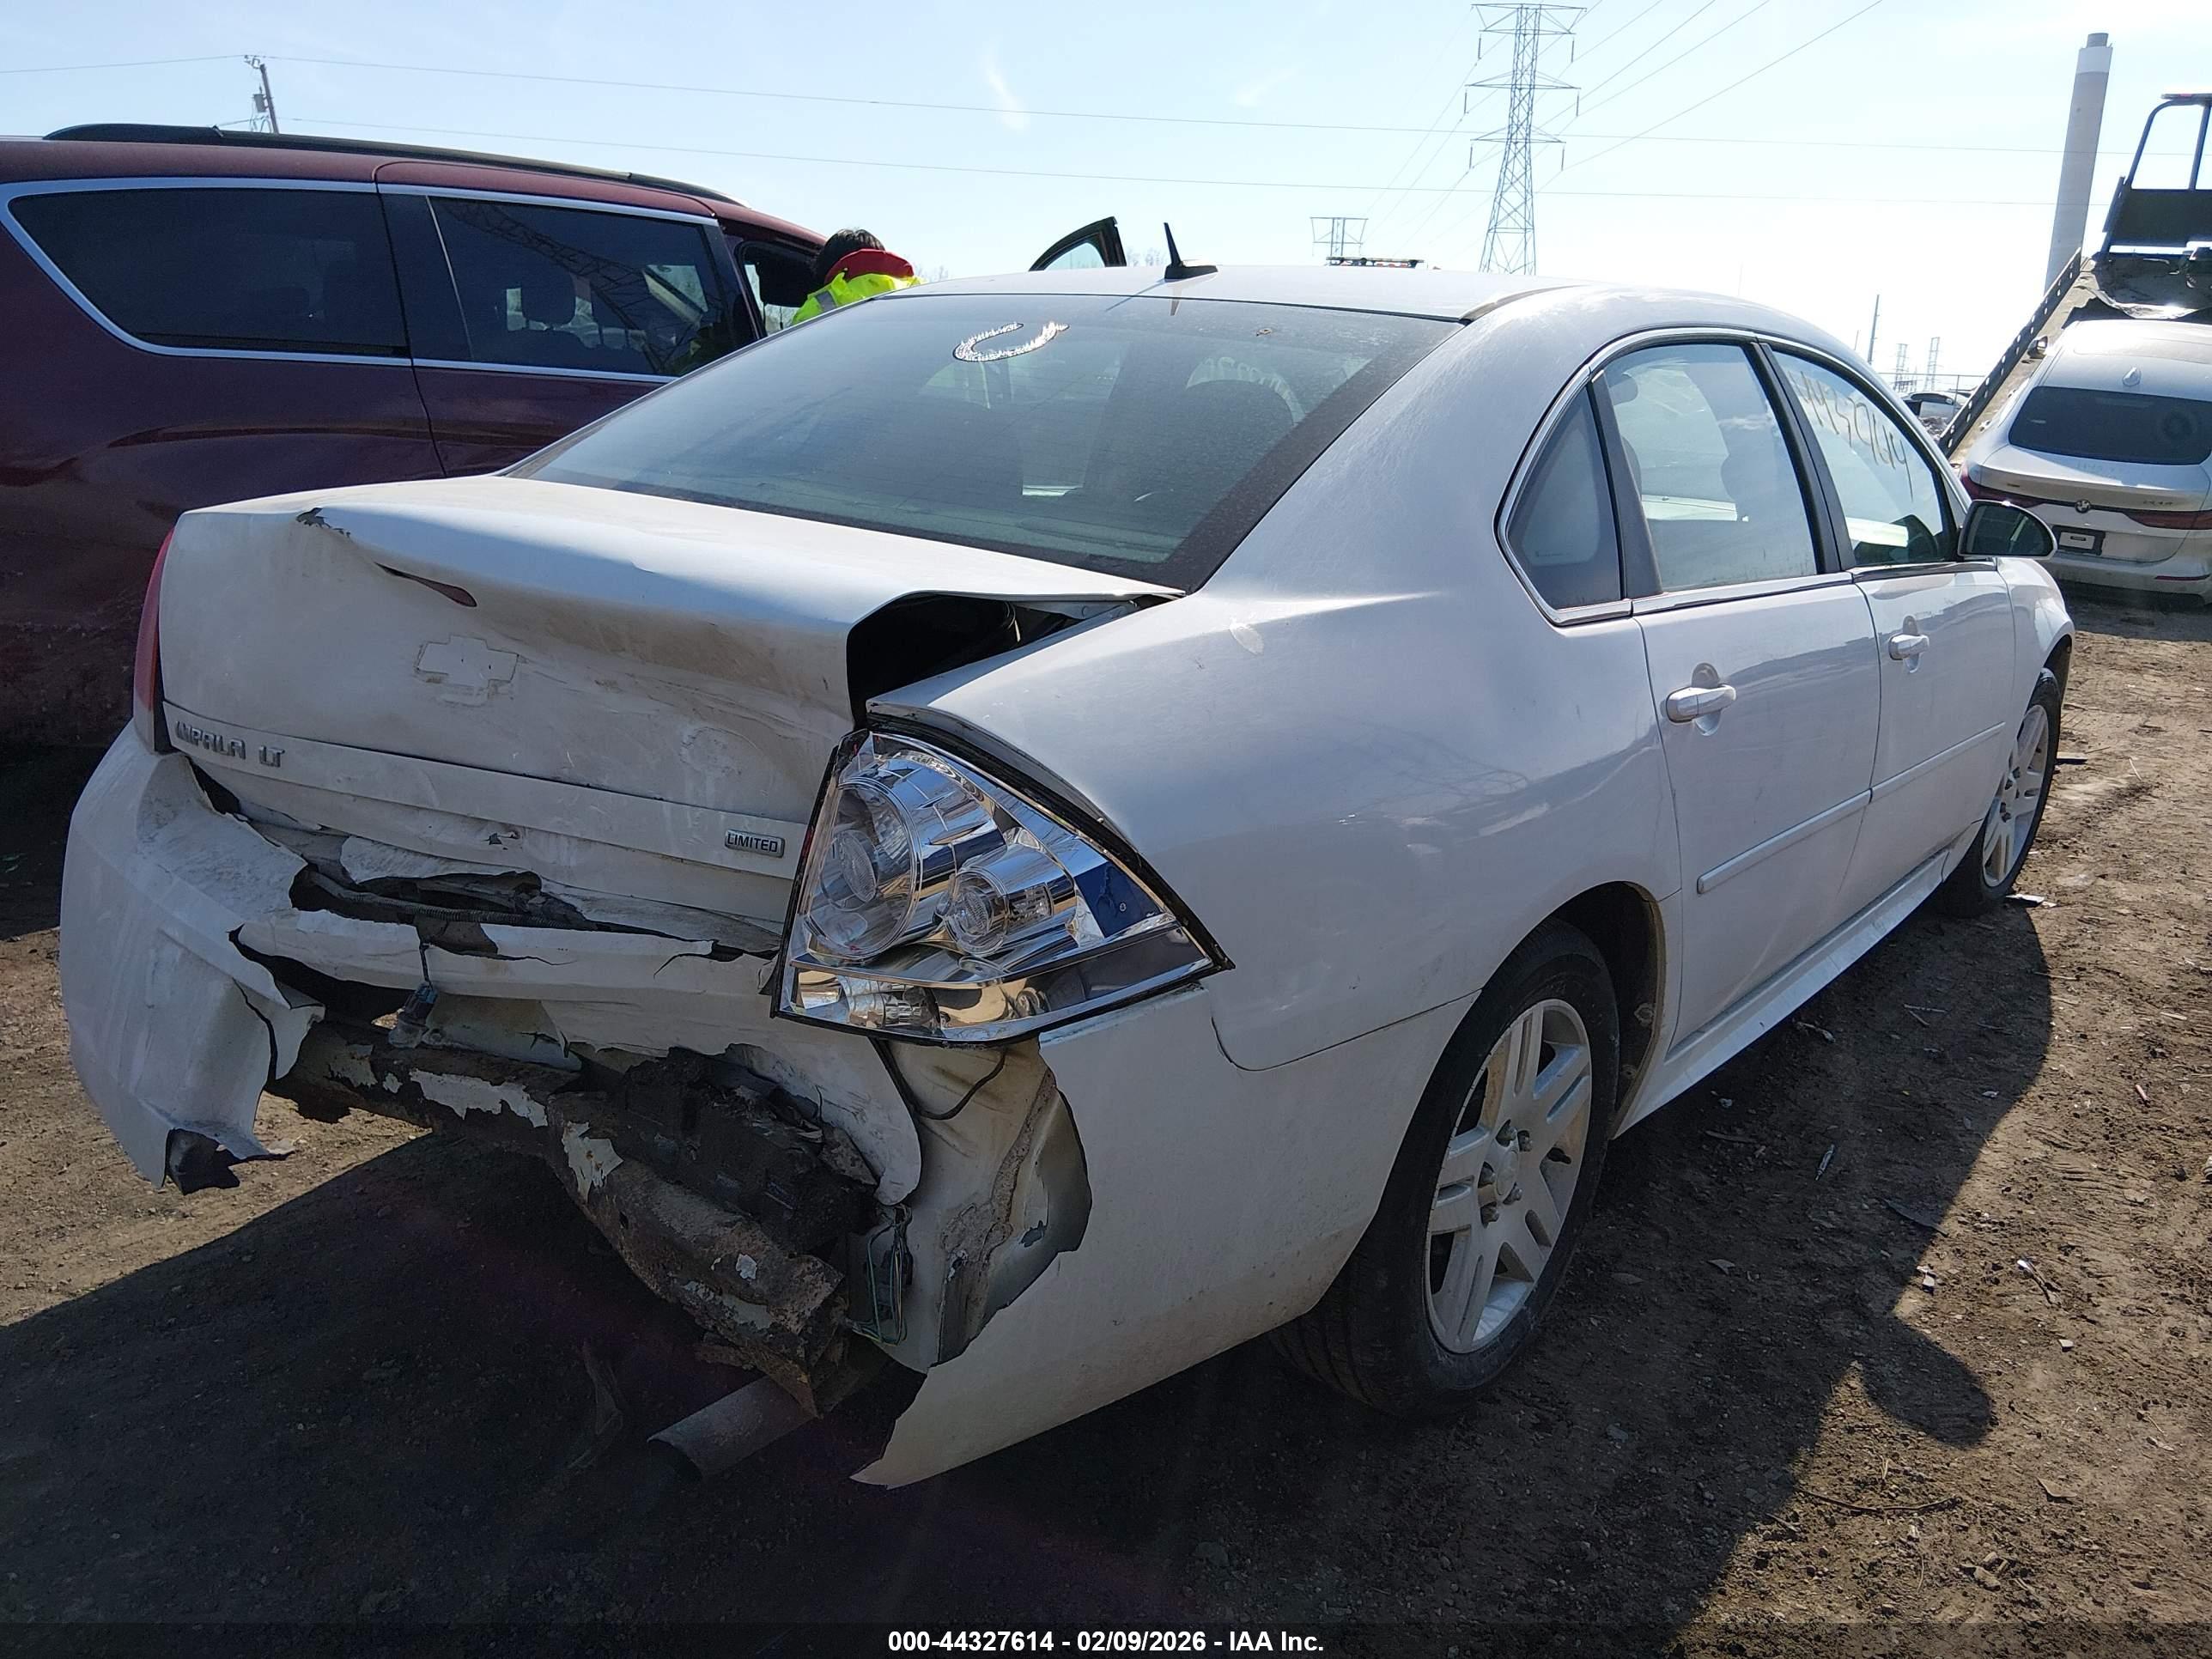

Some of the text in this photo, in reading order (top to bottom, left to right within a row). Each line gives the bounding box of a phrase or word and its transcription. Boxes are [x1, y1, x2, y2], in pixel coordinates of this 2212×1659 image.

[175, 720, 285, 768] IMPALA LT
[727, 832, 778, 853] LIMITED
